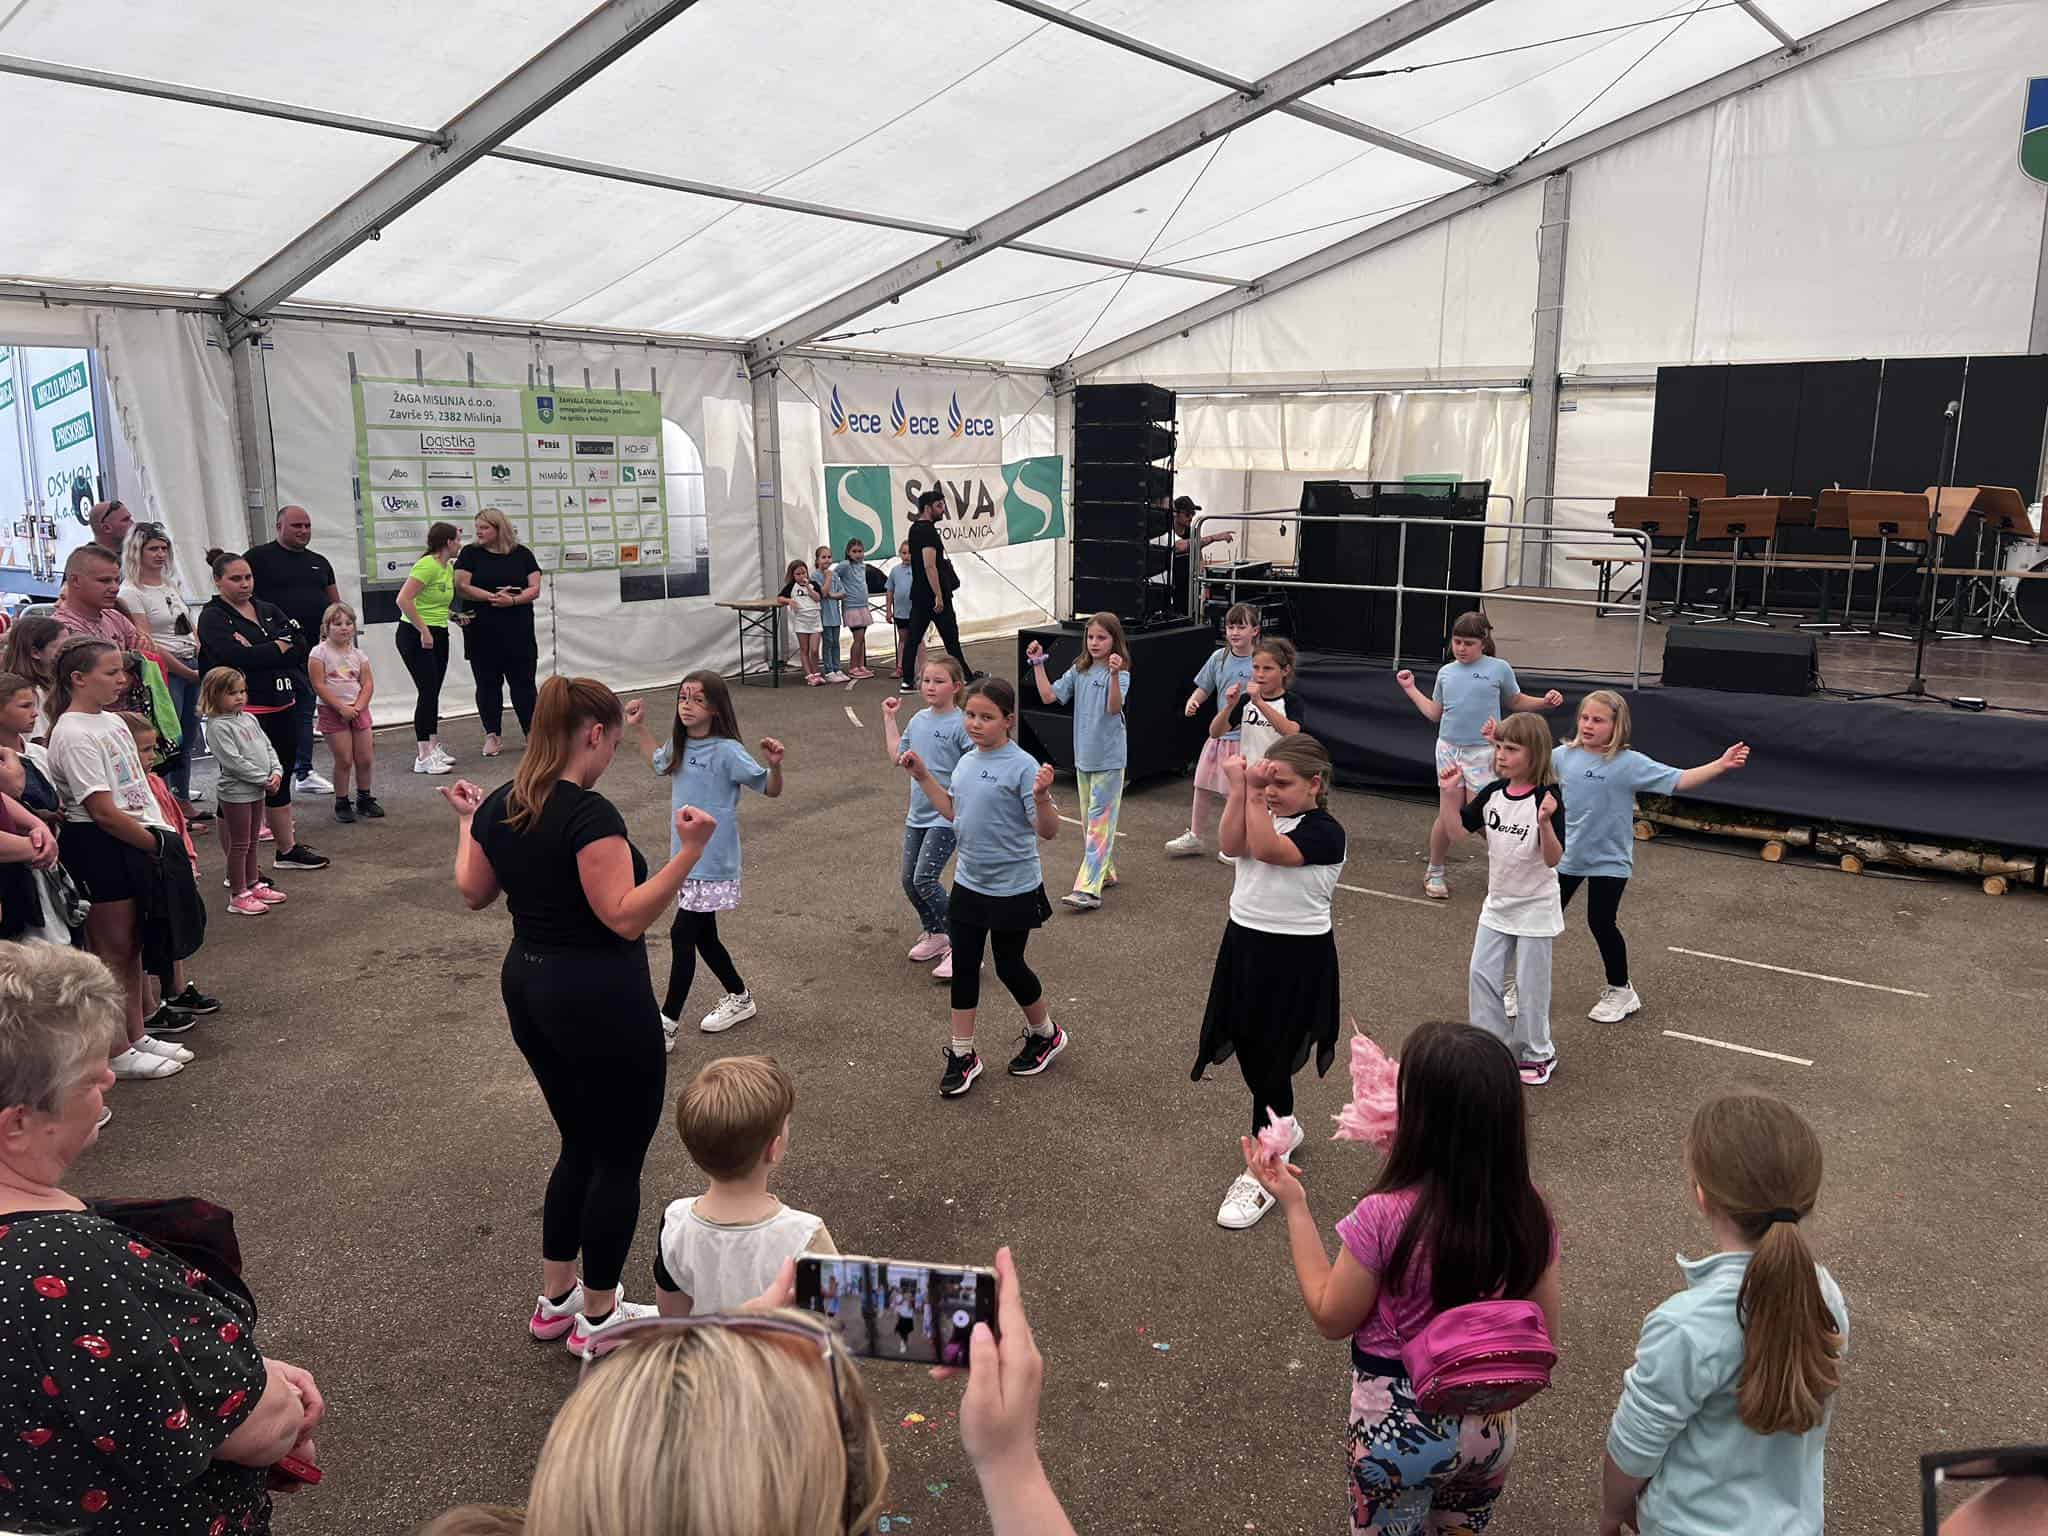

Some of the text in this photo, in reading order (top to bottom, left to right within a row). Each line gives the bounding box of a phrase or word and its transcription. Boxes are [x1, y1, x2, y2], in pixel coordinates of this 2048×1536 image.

[393, 390, 421, 403] ŽAGA
[389, 408, 422, 420] Završe
[439, 411, 462, 422] 2382
[464, 412, 502, 425] Mislinja
[848, 414, 881, 433] ece
[909, 416, 939, 435] ece
[964, 418, 994, 436] ece
[420, 432, 475, 449] Logistika
[938, 524, 995, 540] ROVALNICA
